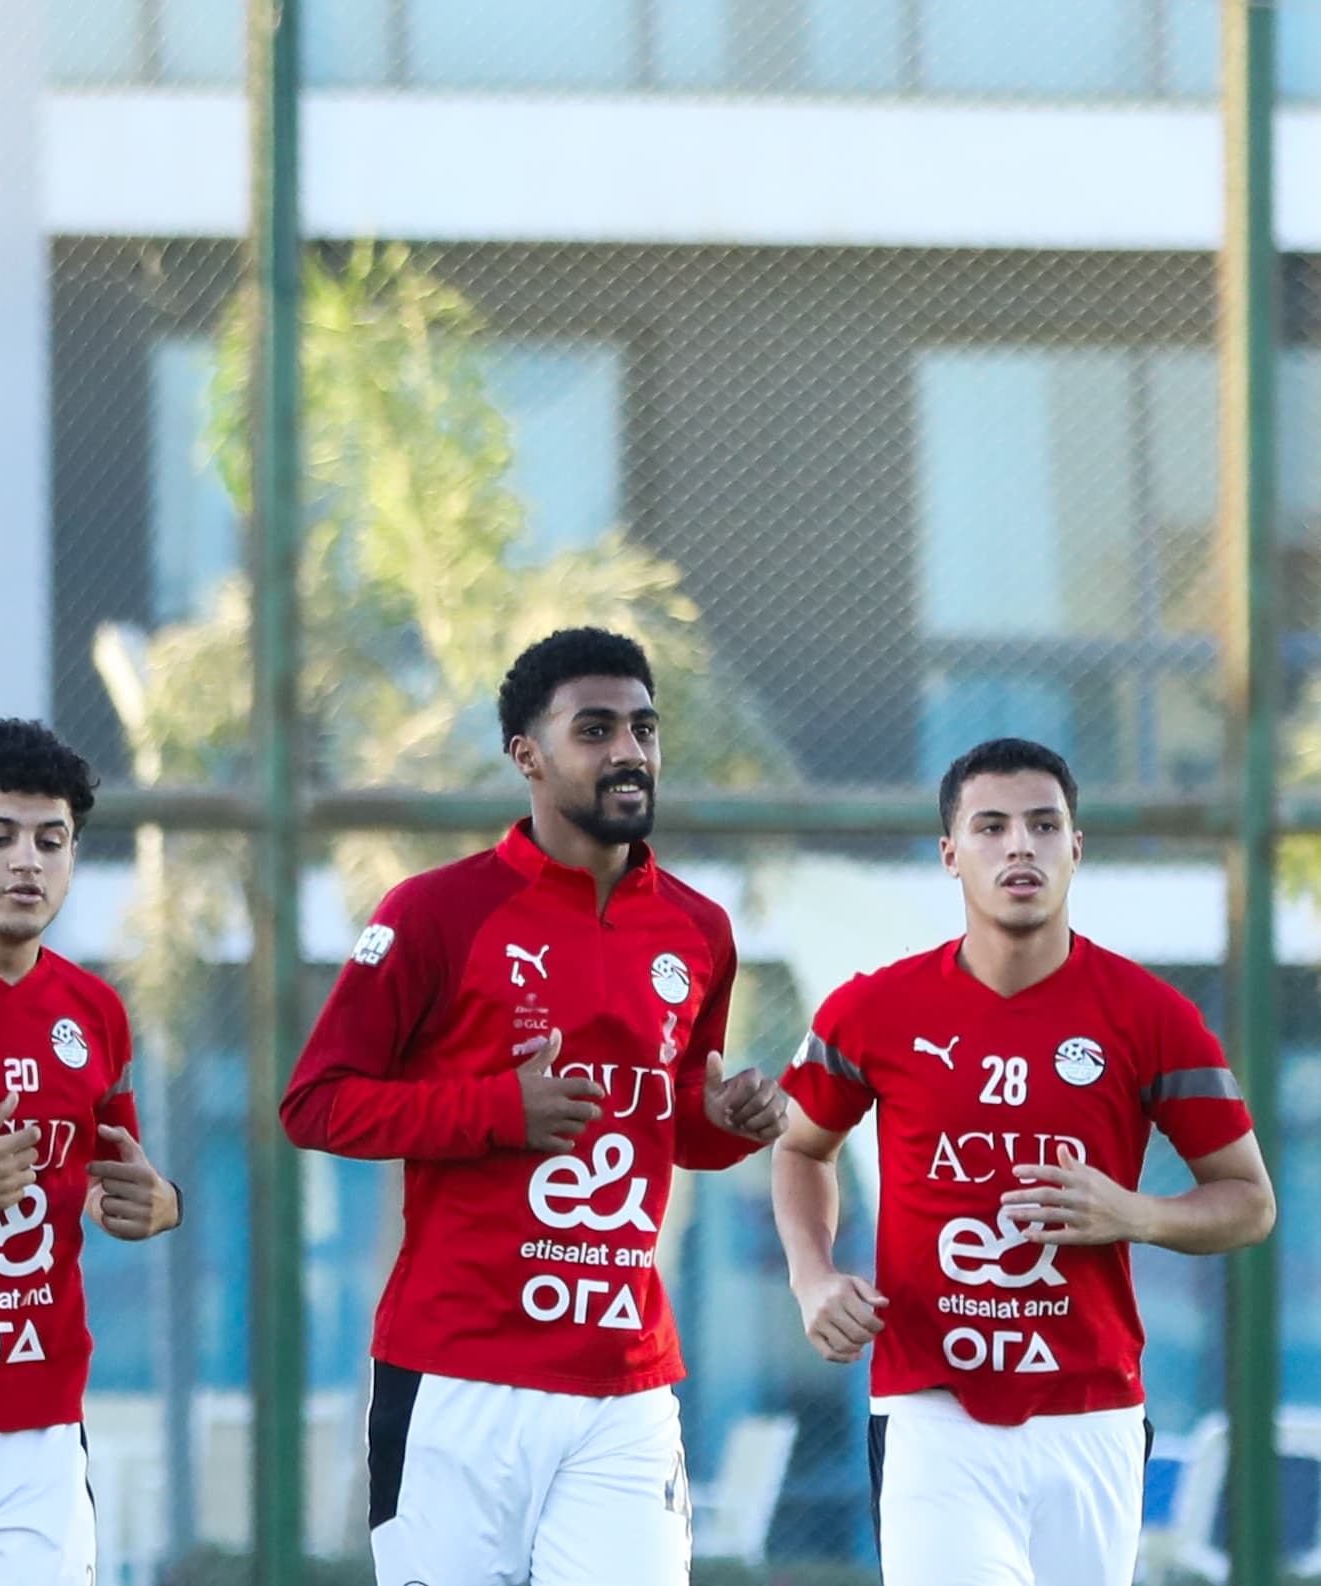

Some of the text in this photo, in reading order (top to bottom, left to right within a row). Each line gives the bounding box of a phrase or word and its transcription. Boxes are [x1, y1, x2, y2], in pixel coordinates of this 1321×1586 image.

[510, 961, 526, 987] 4
[524, 1019, 549, 1030] GLC
[3, 1057, 40, 1093] 20
[978, 1054, 1029, 1107] 28
[520, 1239, 656, 1269] etisalat and
[937, 1293, 1070, 1319] etisalat and
